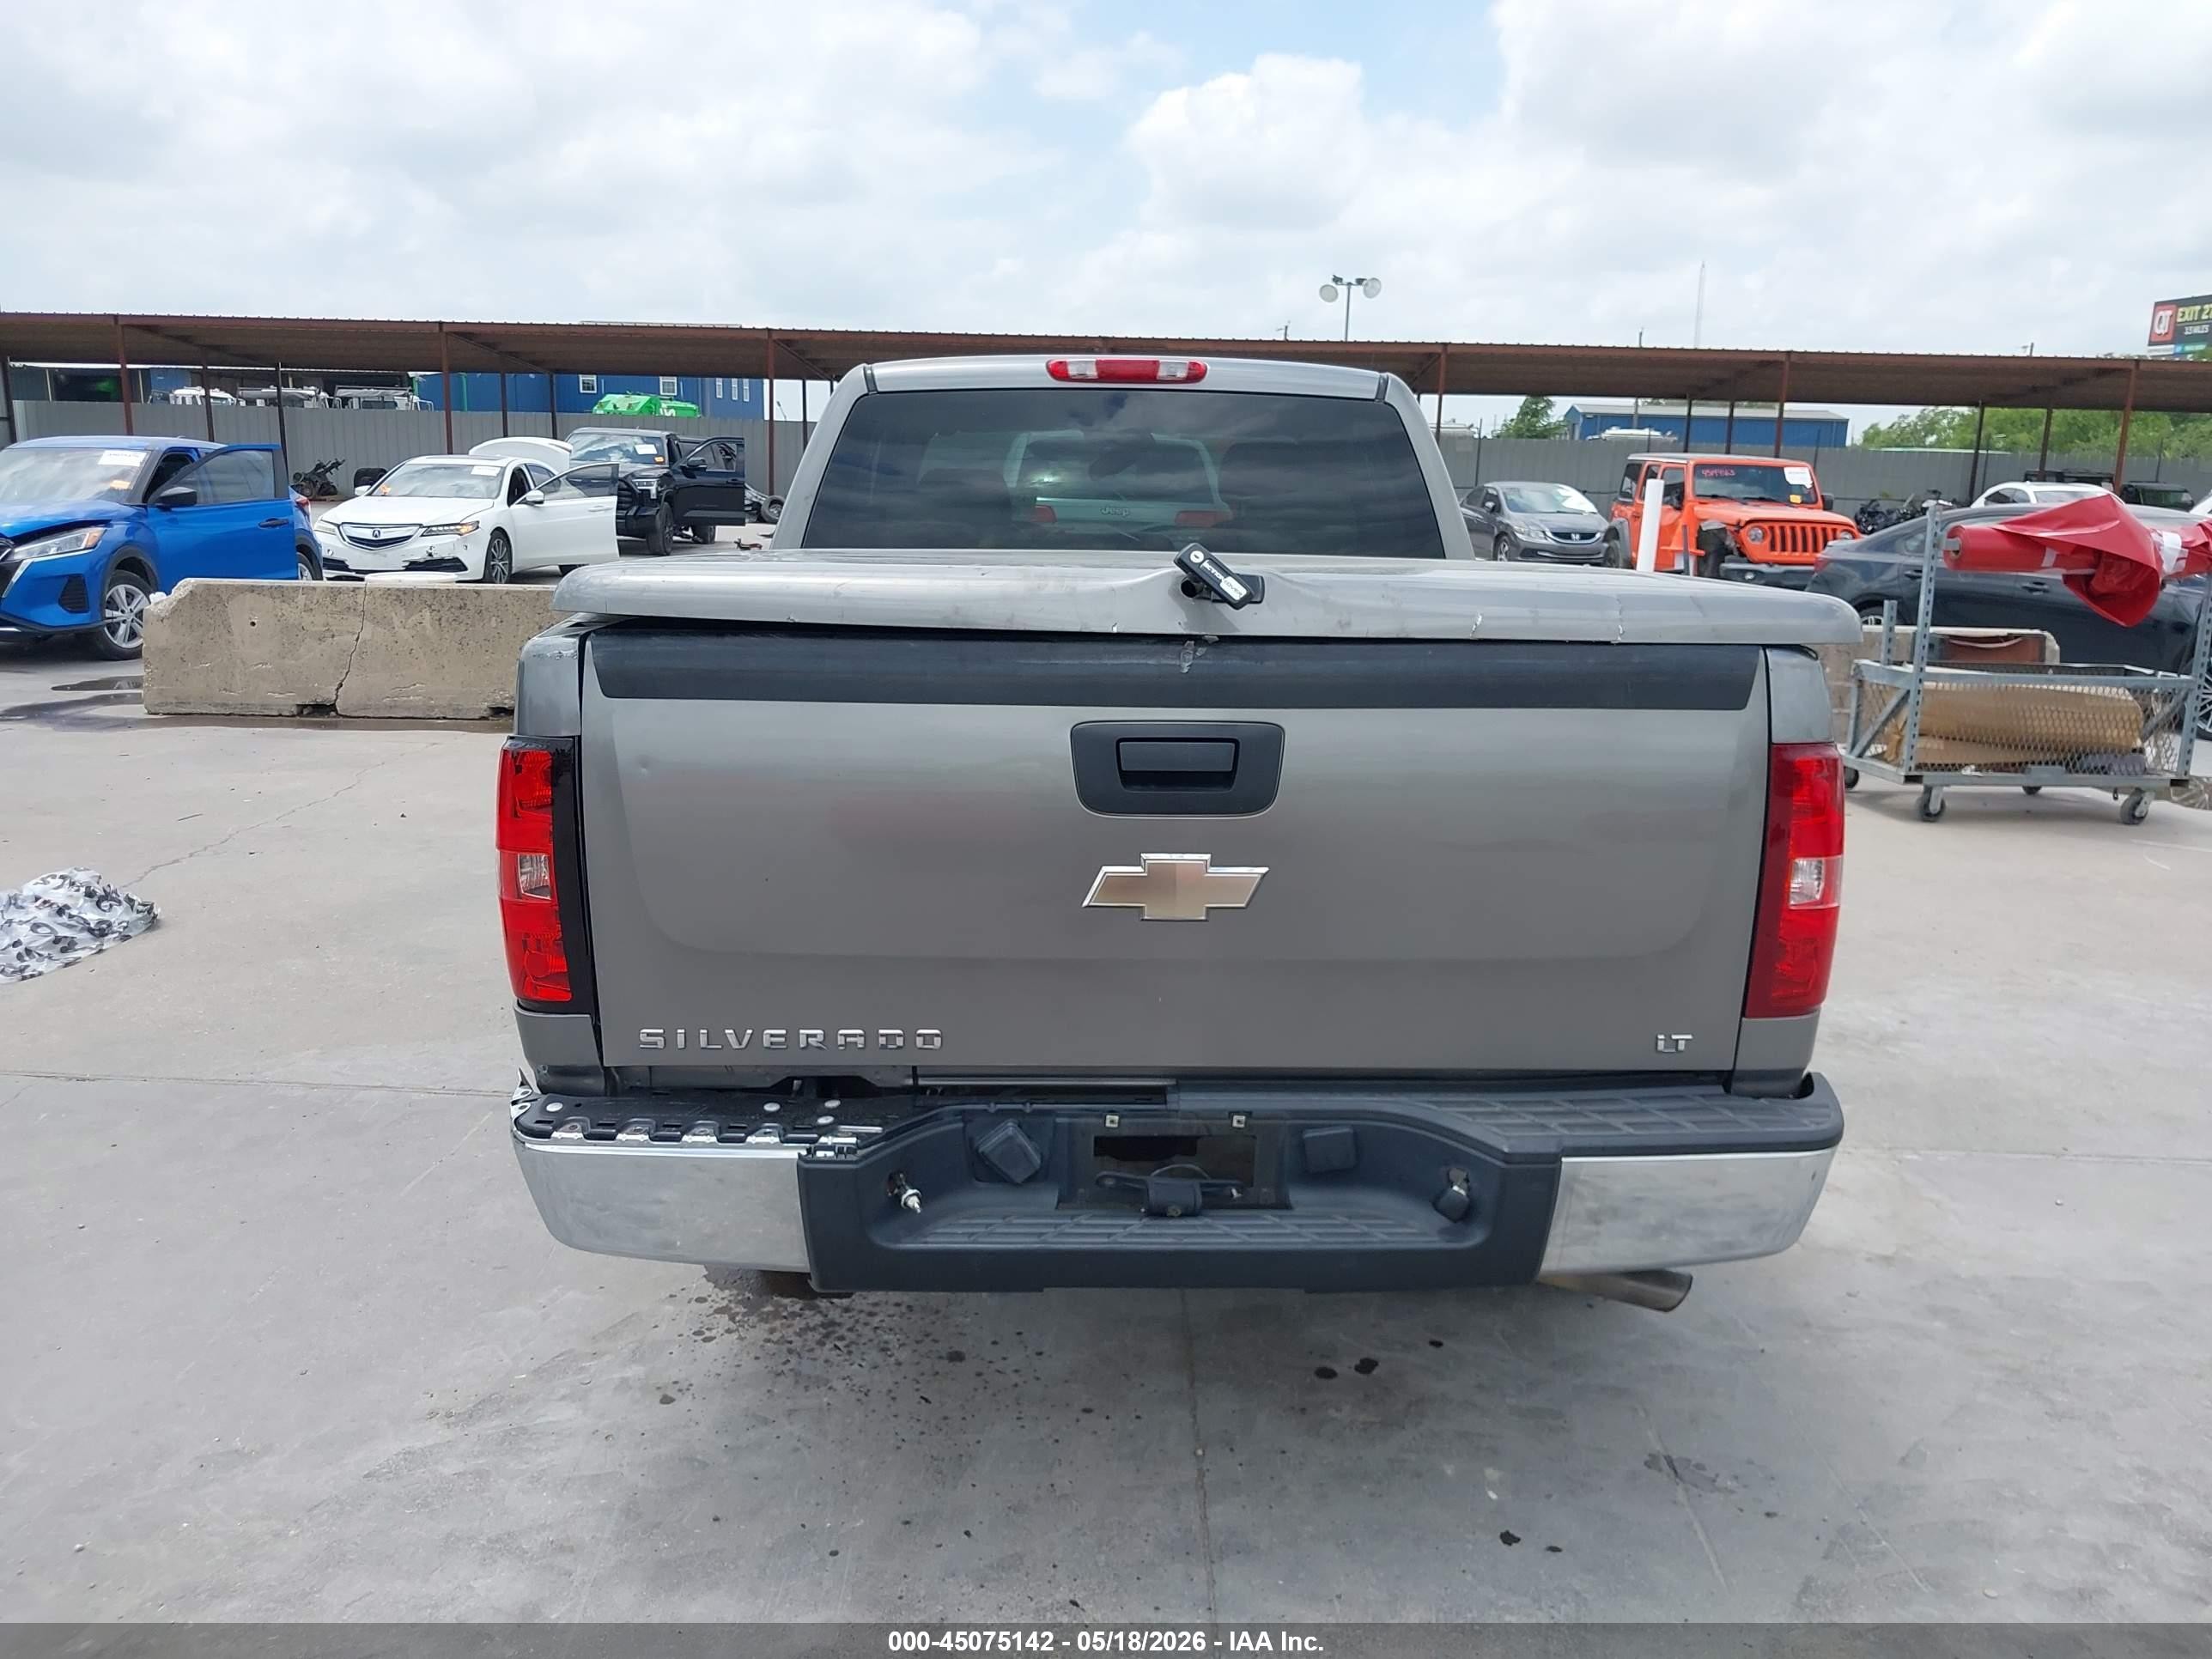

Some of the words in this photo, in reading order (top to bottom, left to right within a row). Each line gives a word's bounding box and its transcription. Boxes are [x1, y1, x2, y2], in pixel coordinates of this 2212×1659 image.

[2154, 310, 2173, 336] QT
[2177, 306, 2201, 322] EXIT
[640, 1029, 943, 1050] SILVERADO
[1656, 1033, 1693, 1053] LT
